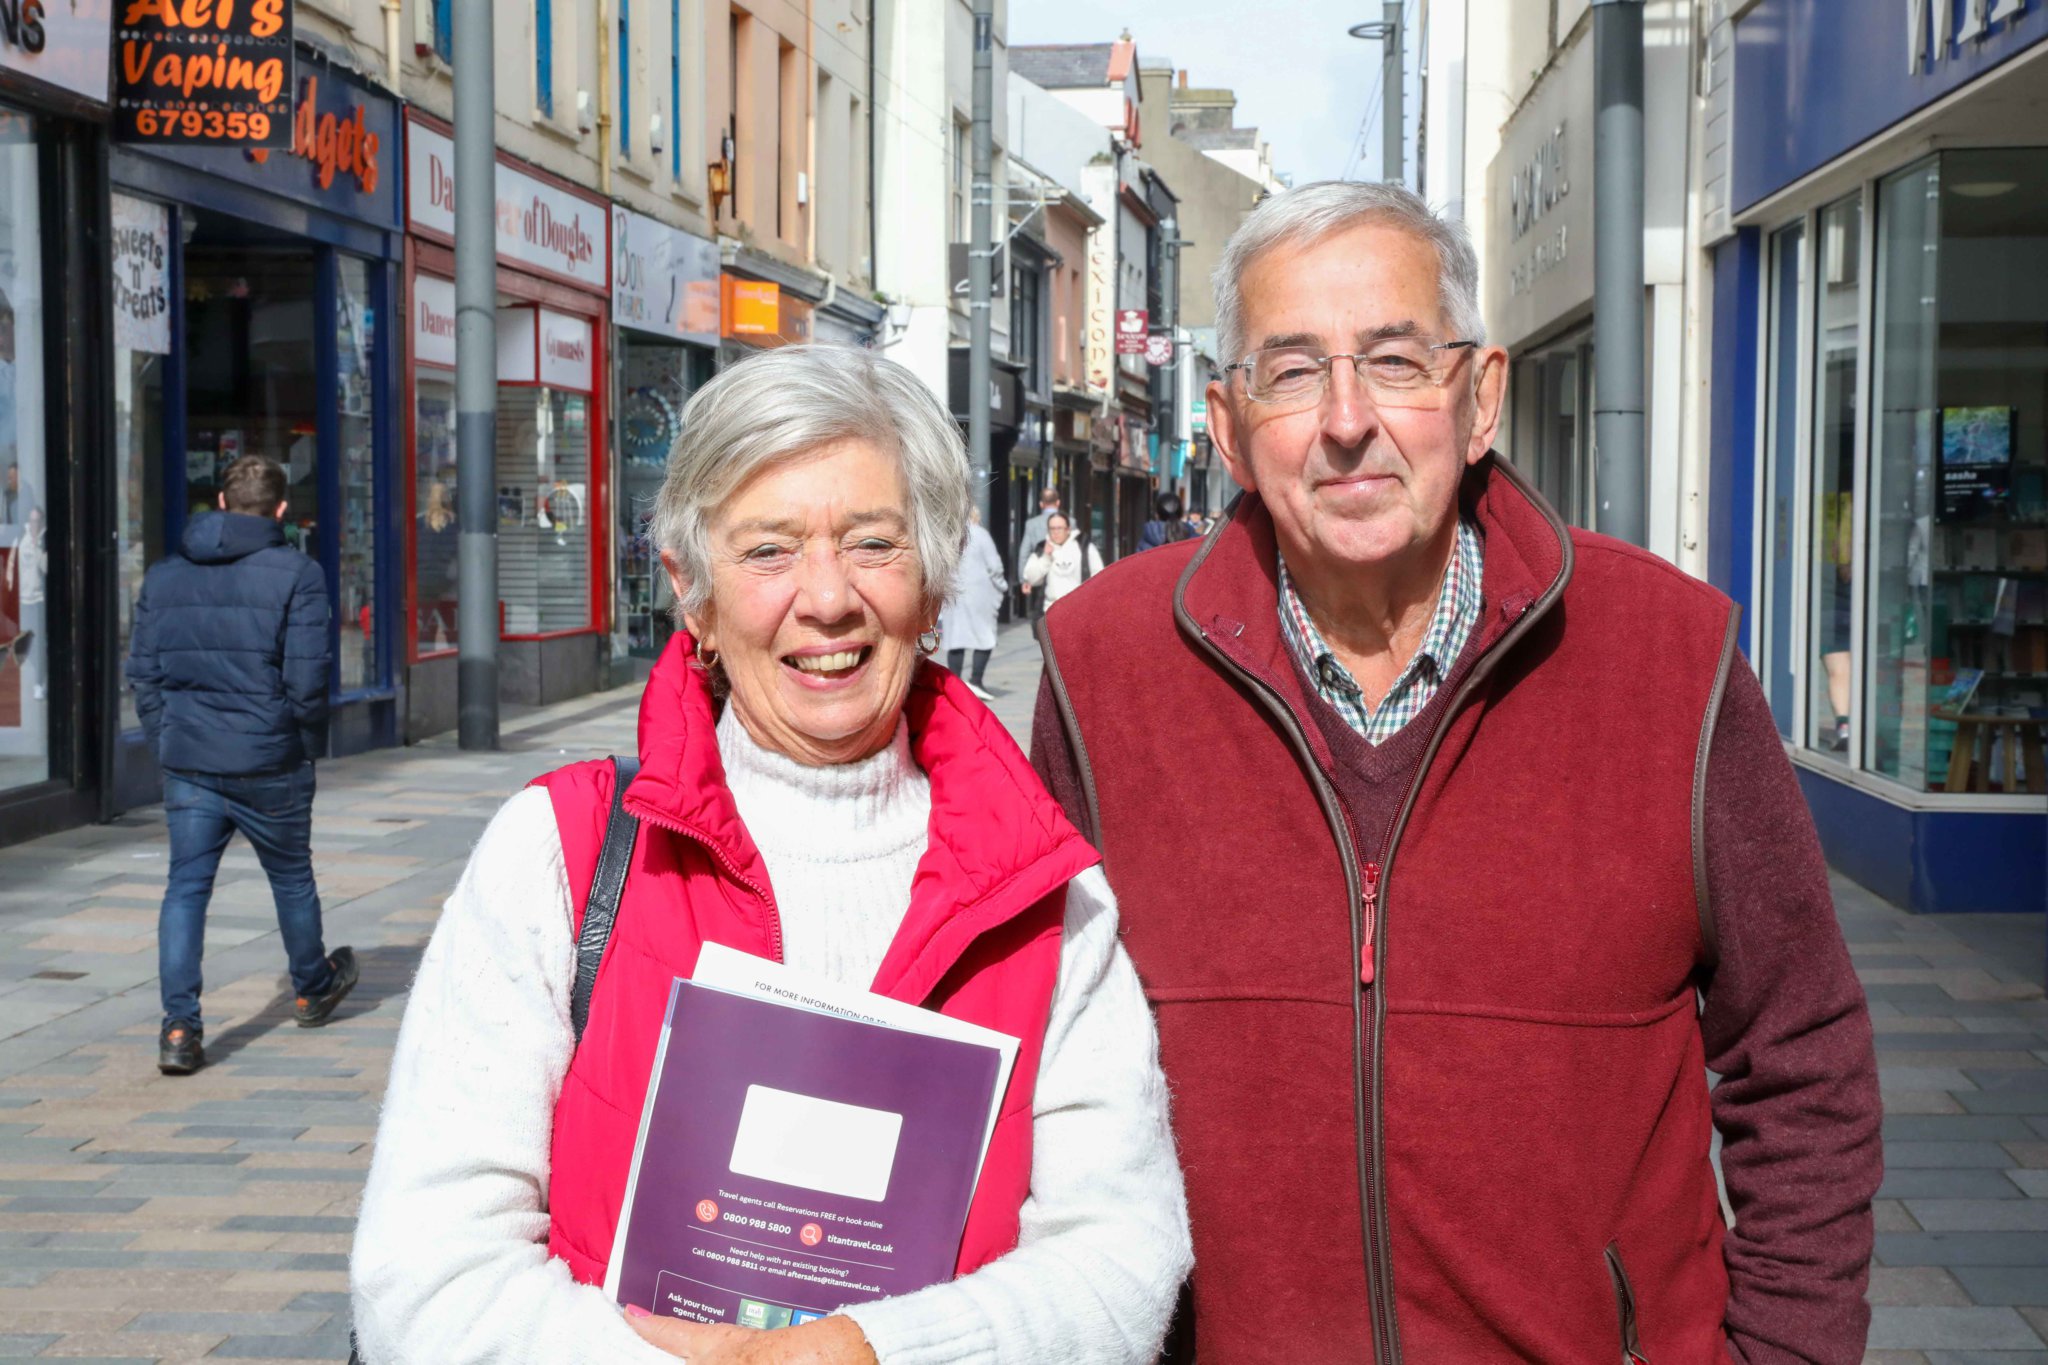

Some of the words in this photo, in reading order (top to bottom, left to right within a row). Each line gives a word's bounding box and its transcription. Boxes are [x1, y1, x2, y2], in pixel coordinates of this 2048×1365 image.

[123, 39, 284, 104] Vaping
[136, 108, 271, 140] 679359
[251, 74, 380, 195] dgets
[524, 195, 539, 244] of
[541, 203, 592, 272] Douglas
[754, 981, 772, 992] FOR
[773, 988, 799, 1001] MORE
[800, 996, 860, 1018] INFORMATION
[718, 1189, 738, 1200] Travel
[739, 1194, 762, 1206] agents
[763, 1199, 776, 1209] call
[777, 1203, 819, 1218] Reservations
[820, 1211, 837, 1221] FREE
[846, 1216, 862, 1226] book
[863, 1219, 883, 1229] online
[723, 1212, 747, 1225] 0800
[749, 1218, 766, 1229] 988
[767, 1222, 791, 1235] 5800
[827, 1234, 894, 1253] titantravel.co.uk
[692, 1247, 705, 1257] Call
[706, 1251, 725, 1262] 0800
[726, 1256, 740, 1266] 988
[741, 1259, 758, 1270] 5811
[768, 1266, 786, 1277] email
[787, 1270, 881, 1293] aftersales@titantravel.co.uk
[729, 1246, 748, 1257] Need
[749, 1250, 766, 1262] help
[766, 1254, 781, 1264] with
[792, 1260, 818, 1273] existing
[819, 1264, 849, 1278] booking?
[668, 1292, 682, 1303] Ask
[683, 1298, 701, 1309] your
[701, 1303, 725, 1317] travel
[673, 1306, 695, 1320] agent
[696, 1313, 708, 1323] for
